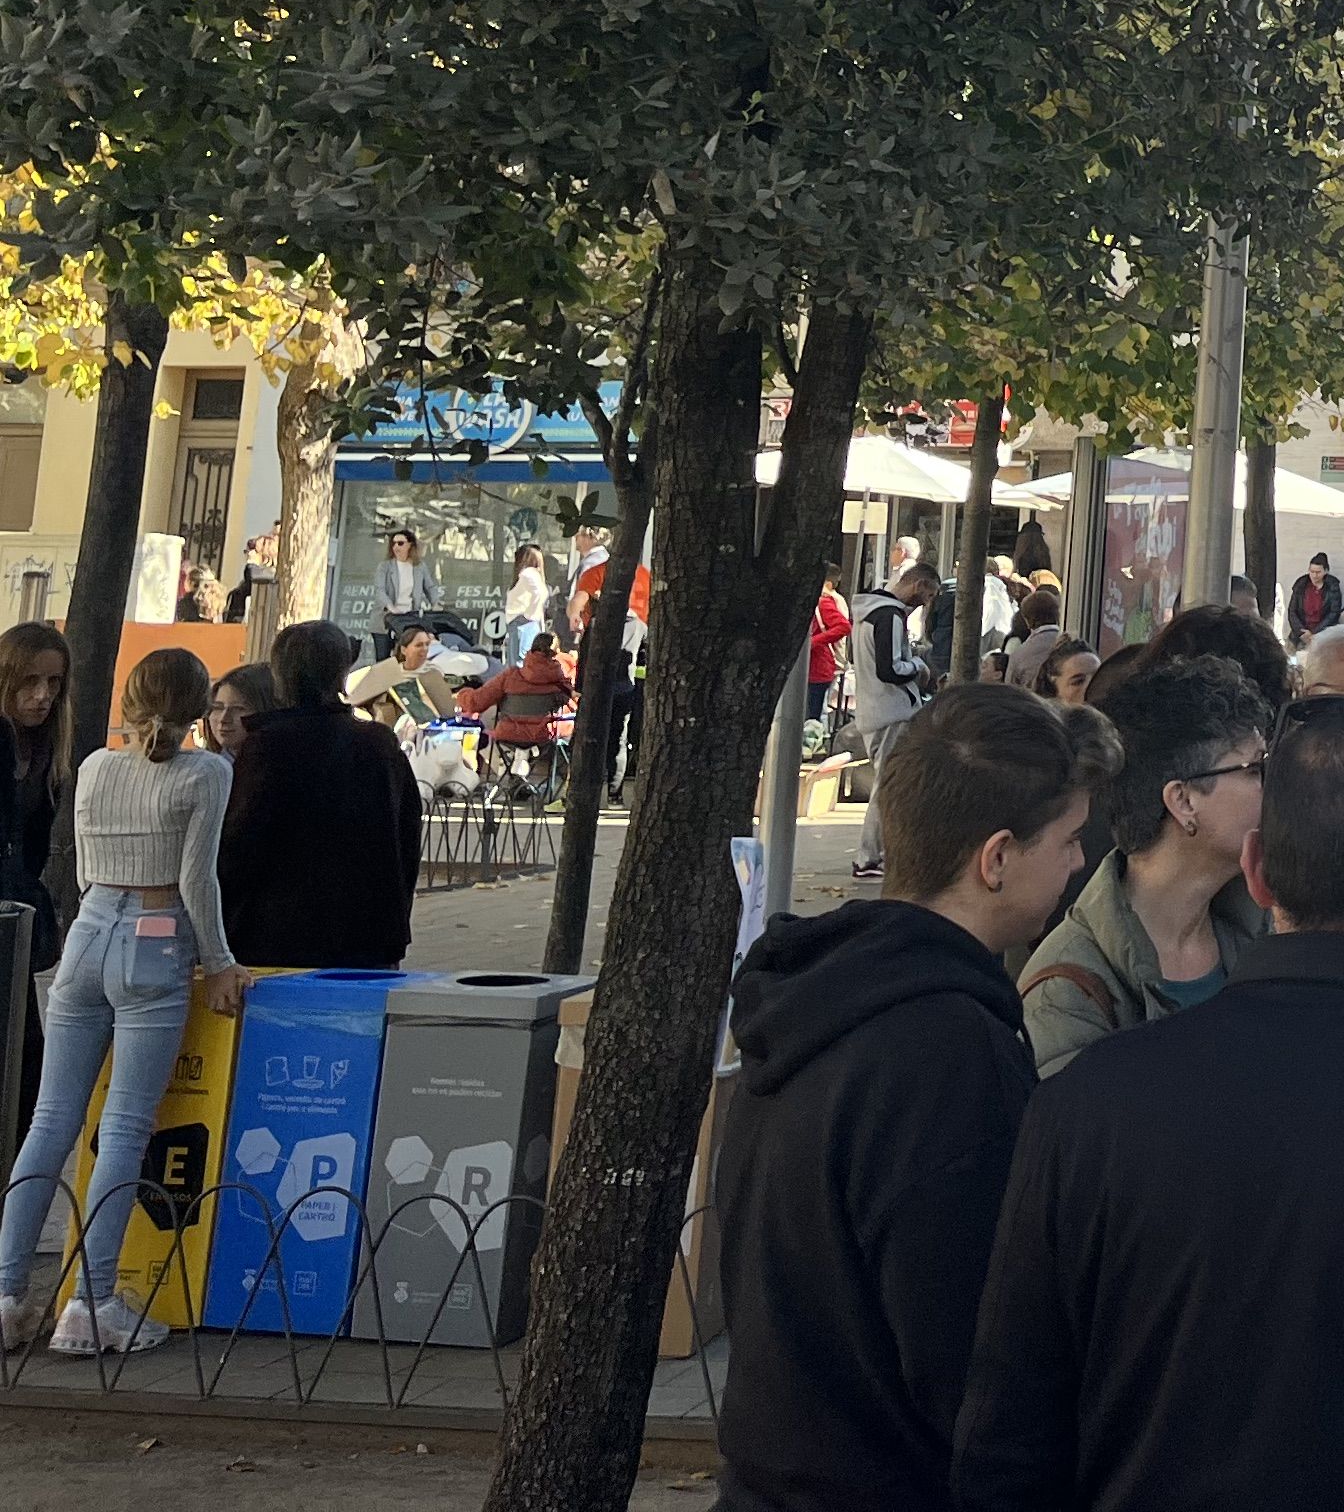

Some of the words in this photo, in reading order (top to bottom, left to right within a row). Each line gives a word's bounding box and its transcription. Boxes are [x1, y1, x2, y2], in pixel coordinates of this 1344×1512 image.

[457, 586, 481, 597] FES
[485, 586, 501, 597] LA
[163, 1147, 189, 1185] E
[310, 1155, 337, 1190] P
[462, 1166, 492, 1206] R
